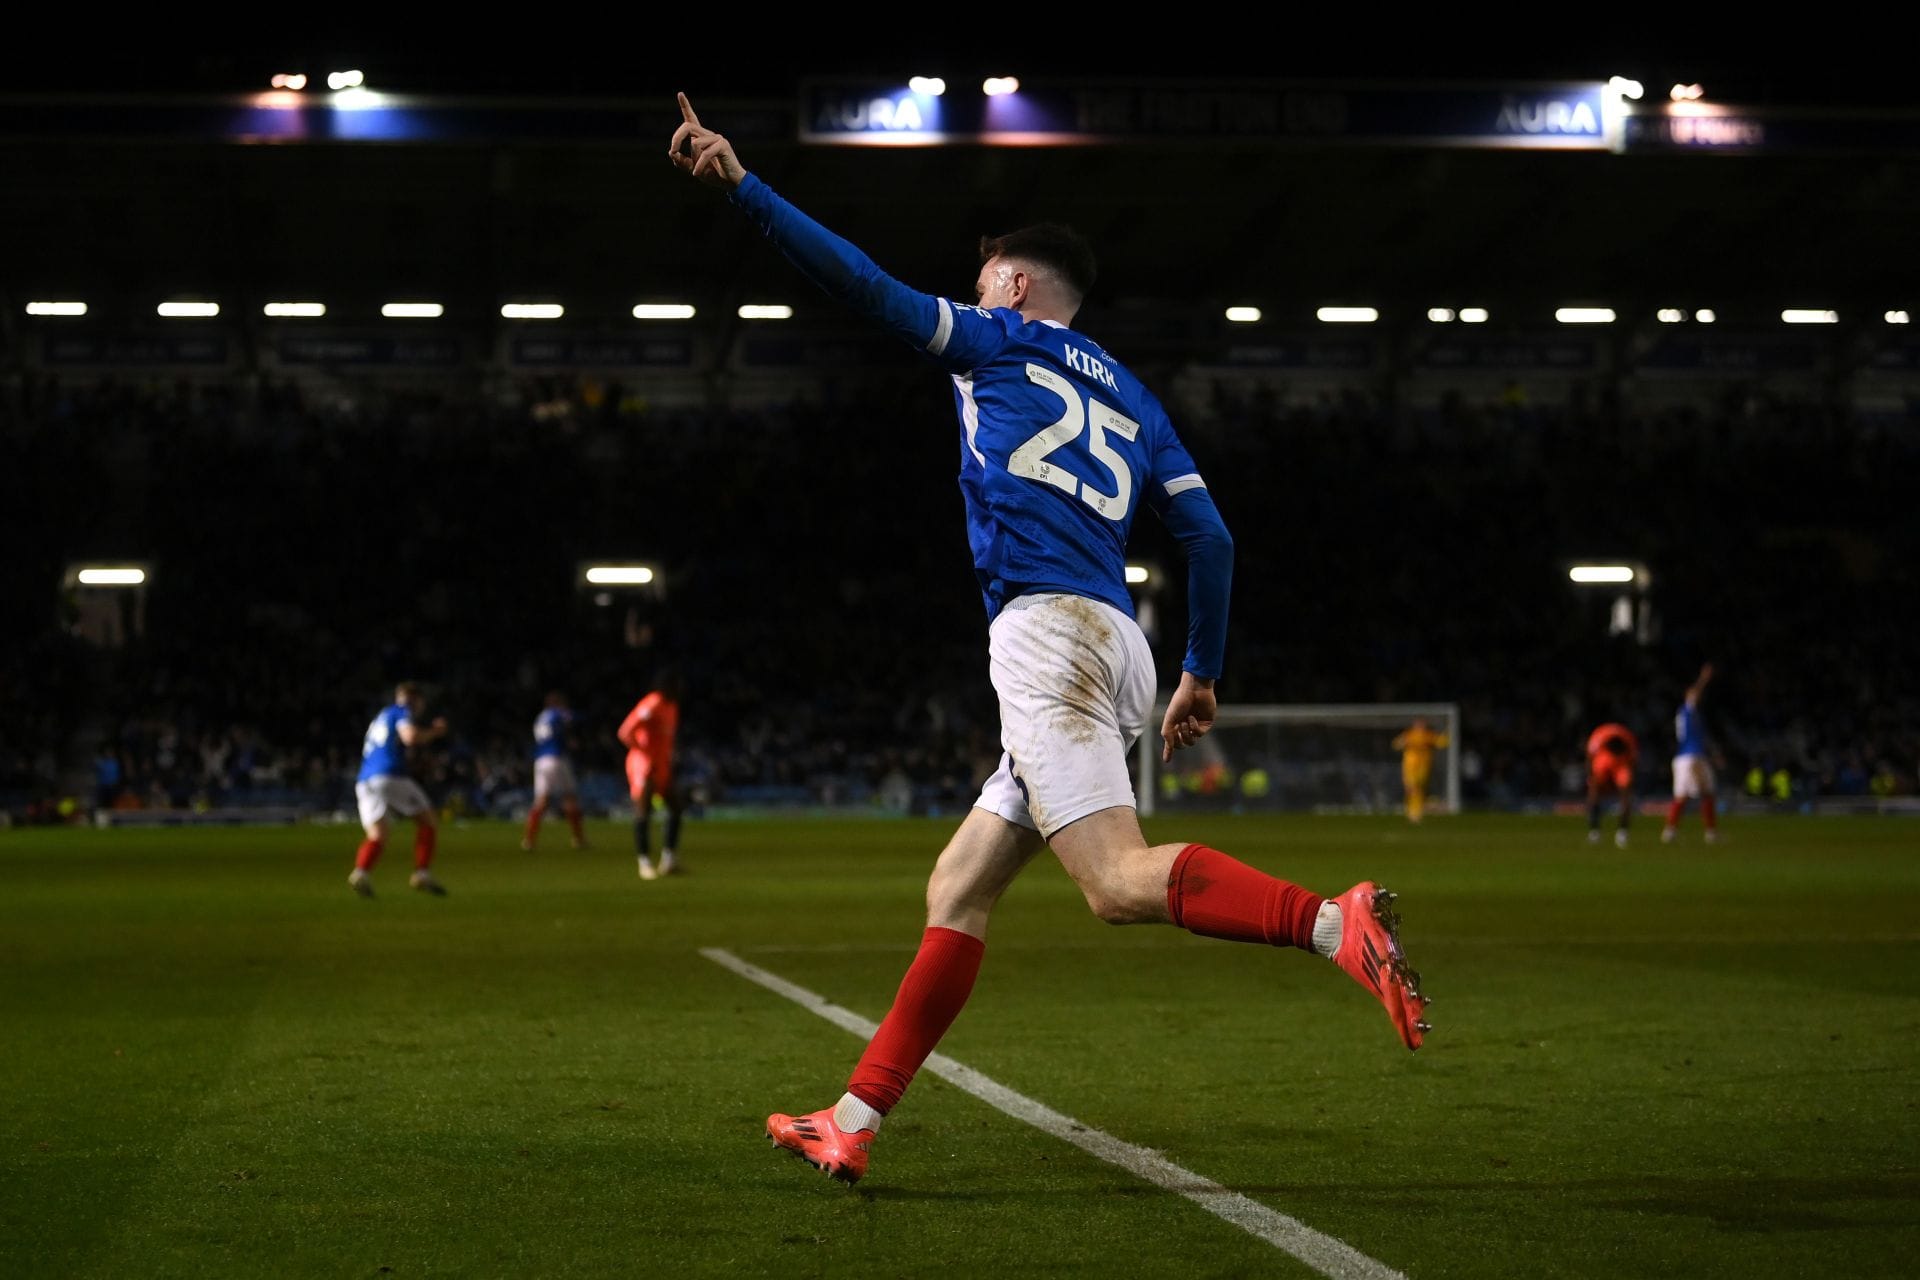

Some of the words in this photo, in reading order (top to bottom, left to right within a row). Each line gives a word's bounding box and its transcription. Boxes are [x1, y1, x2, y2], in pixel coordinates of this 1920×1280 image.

[817, 97, 924, 131] AURA
[1496, 101, 1598, 133] AURA
[1064, 343, 1119, 392] KIRK
[1007, 362, 1140, 521] 25
